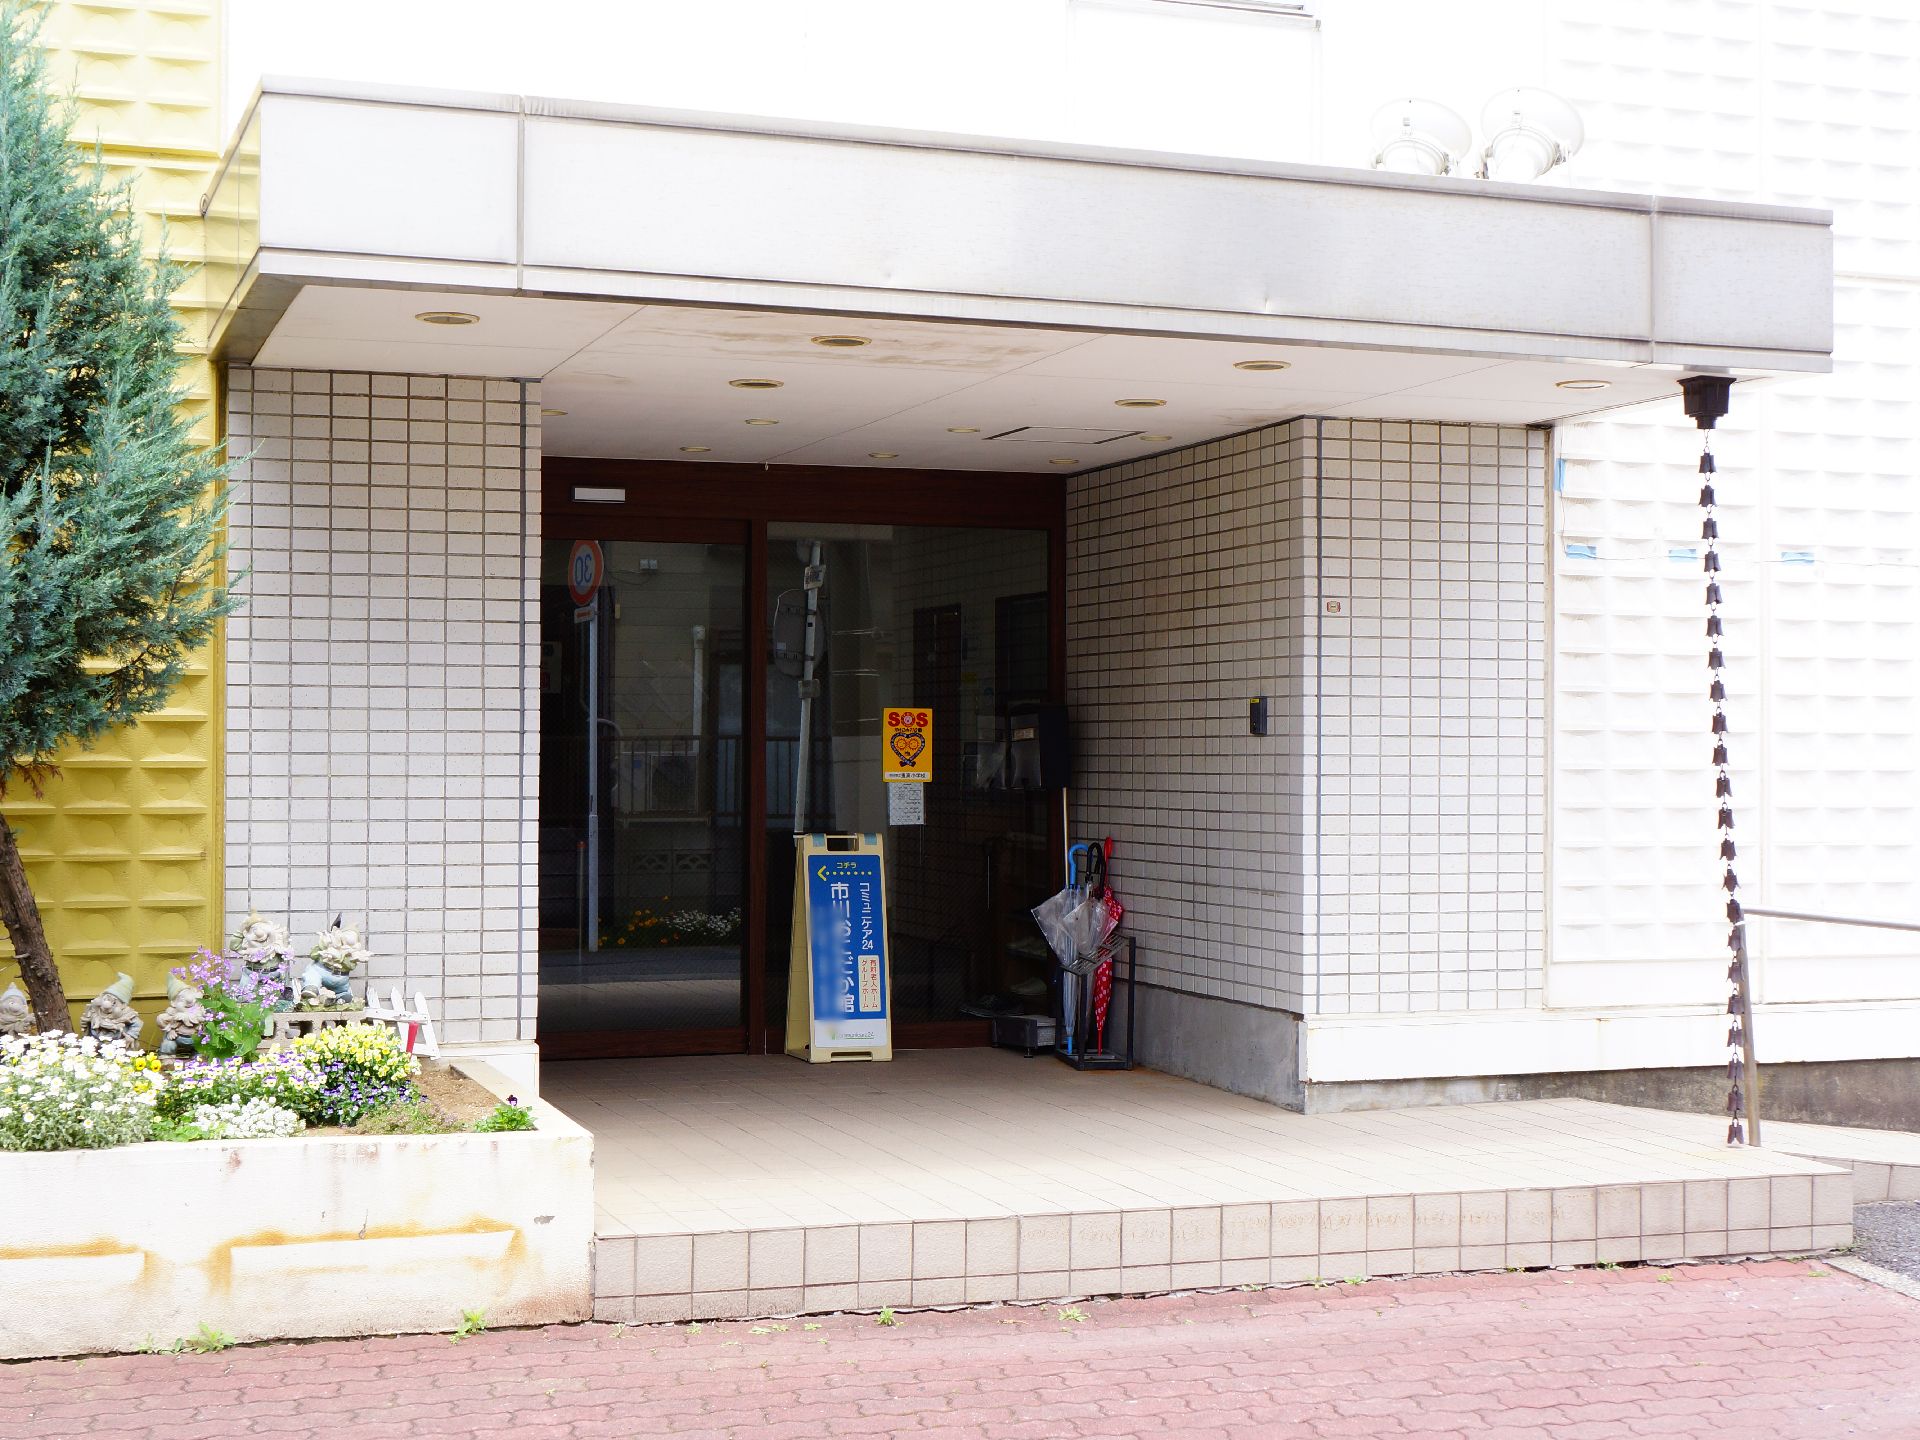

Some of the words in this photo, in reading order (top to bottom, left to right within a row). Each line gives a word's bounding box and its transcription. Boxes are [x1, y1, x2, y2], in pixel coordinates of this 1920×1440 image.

[888, 711, 928, 727] SOS
[859, 882, 874, 950] コミュニケア24
